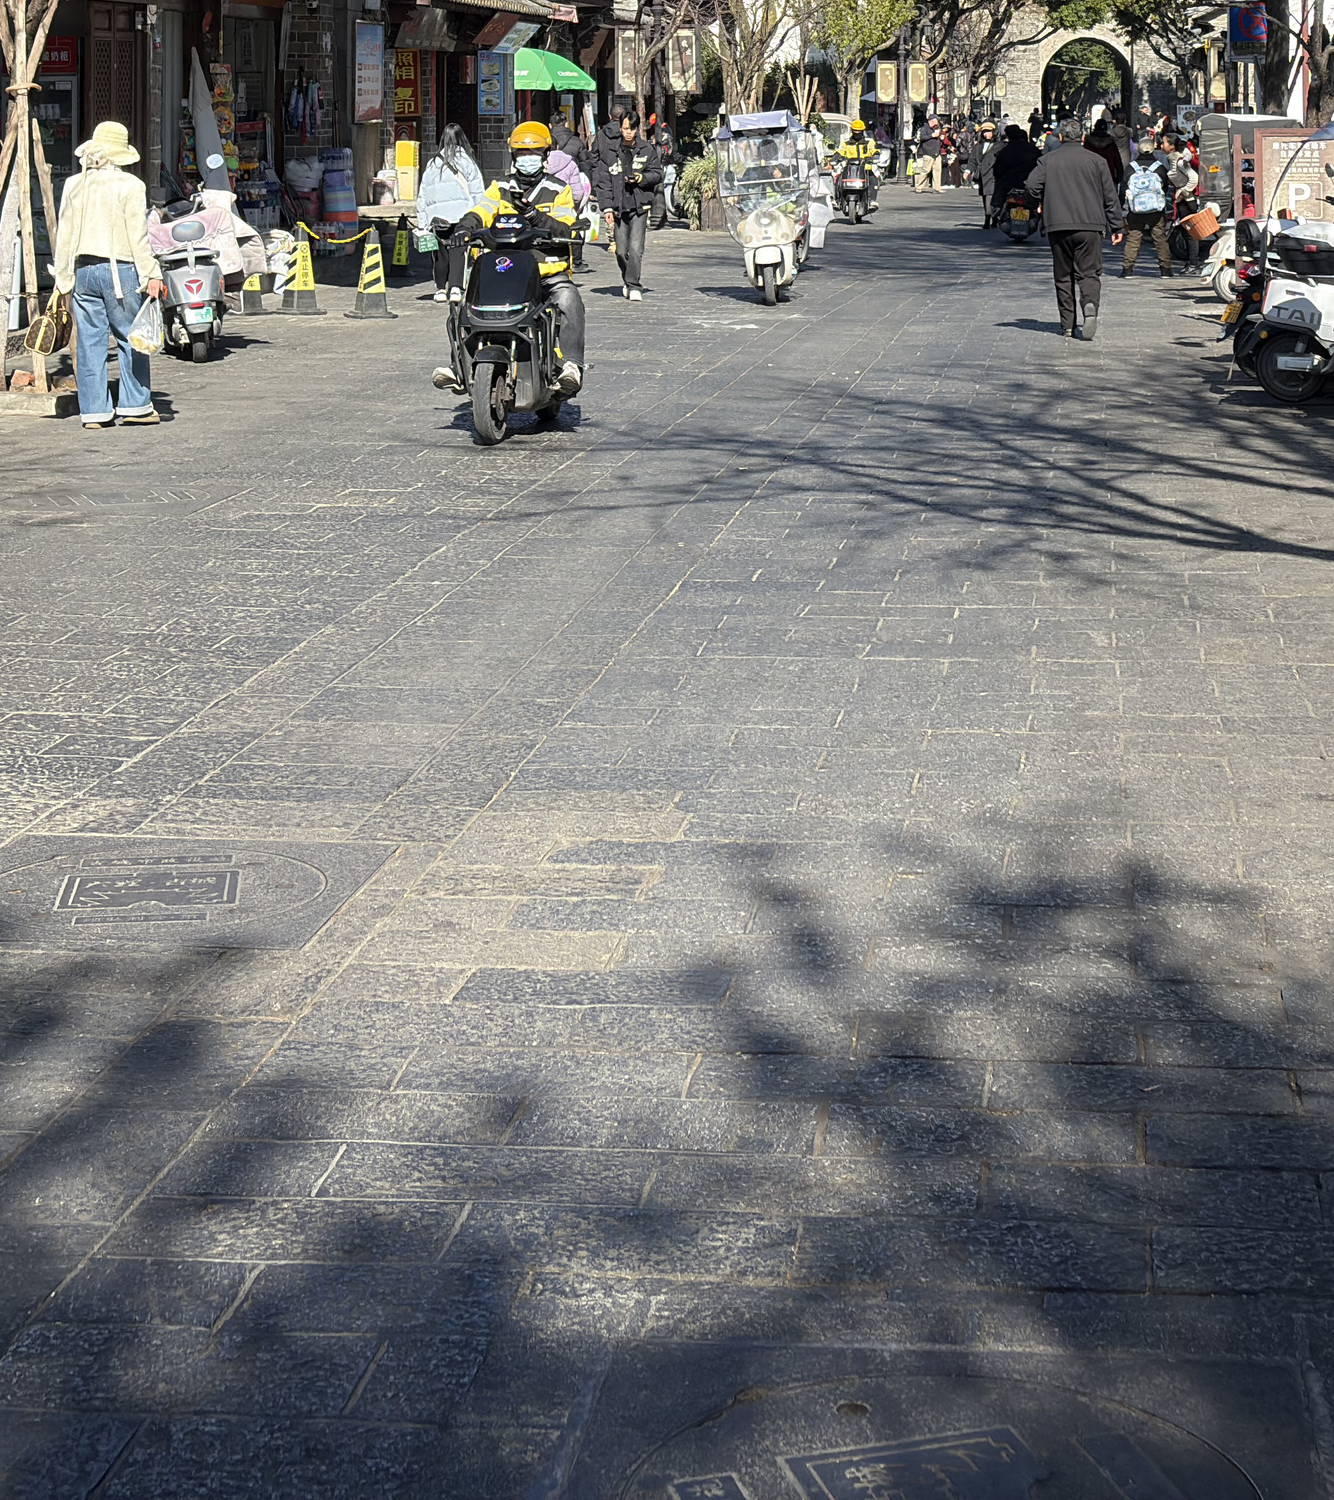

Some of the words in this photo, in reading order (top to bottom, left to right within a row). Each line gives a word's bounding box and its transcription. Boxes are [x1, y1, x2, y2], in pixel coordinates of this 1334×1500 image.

[394, 52, 414, 80] 照相
[394, 87, 415, 114] 复印
[1289, 183, 1311, 211] P
